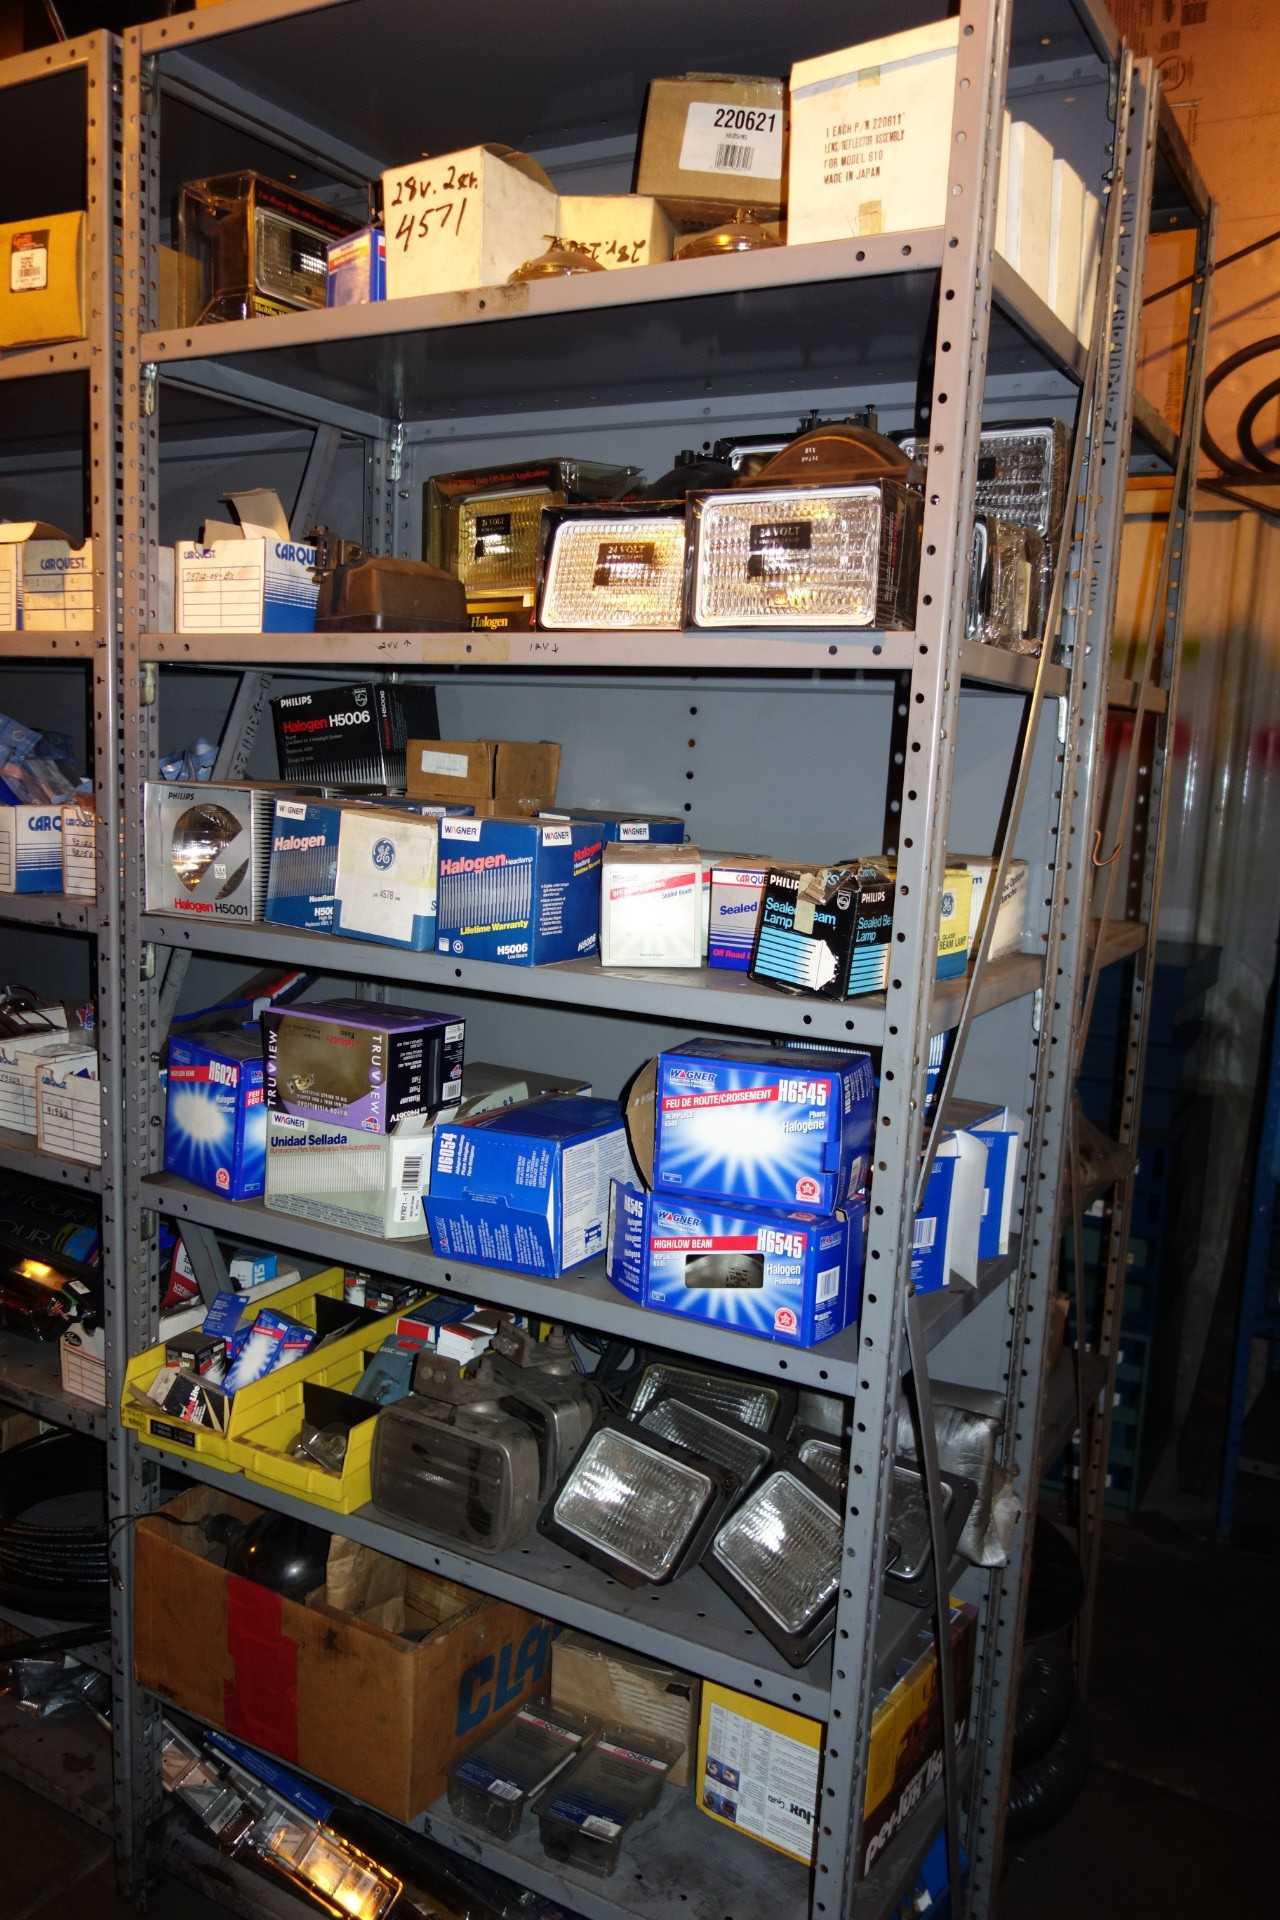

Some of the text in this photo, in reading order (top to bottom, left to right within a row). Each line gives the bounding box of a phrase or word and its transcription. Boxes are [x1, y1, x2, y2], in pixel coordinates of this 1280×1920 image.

[713, 108, 776, 133] 220621
[832, 123, 852, 137] EACH
[824, 166, 881, 185] MADE IN JAPAN
[395, 197, 467, 252] 4571
[773, 526, 800, 536] VOLT
[275, 543, 317, 565] CARQU
[471, 615, 508, 630] Halogen
[281, 695, 312, 708] PHILIPS
[283, 710, 370, 733] Halogen H5006
[168, 791, 195, 801] PHILIPS
[28, 815, 62, 832] CARQ
[622, 827, 648, 836] WAGNER
[273, 834, 326, 851] Halogen
[544, 831, 570, 841] WAGNER
[440, 853, 507, 877] Halogen
[736, 873, 768, 885] CARQUE
[770, 874, 800, 891] PHILIP
[861, 891, 886, 903] PHILIPS
[174, 898, 248, 916] Halogen H5001
[720, 902, 758, 916] Sealed
[763, 909, 793, 929] Lamp
[813, 910, 836, 925] eam
[858, 915, 881, 929] Sealed
[460, 920, 529, 935] Lifetime Warranty
[856, 930, 877, 943] Lamp
[497, 943, 528, 955] H5006
[208, 1060, 238, 1088] H6024
[267, 1030, 279, 1106] TRUVIEW
[369, 1034, 383, 1115] TRUVIEW
[671, 1068, 717, 1082] WAGNER
[666, 1088, 772, 1108] FEU DE ROUTE/CROISEMENT
[778, 1079, 827, 1107] H6545
[273, 1115, 305, 1129] WAGNER
[271, 1133, 348, 1148] Unidad Sellada
[437, 1132, 458, 1174] H6054
[657, 1209, 700, 1227] WAGNER
[654, 1238, 713, 1249] HIGH/LOW BEAM
[757, 1228, 803, 1259] H6545
[766, 1263, 801, 1276] Halogen
[457, 1624, 561, 1738] CLA
